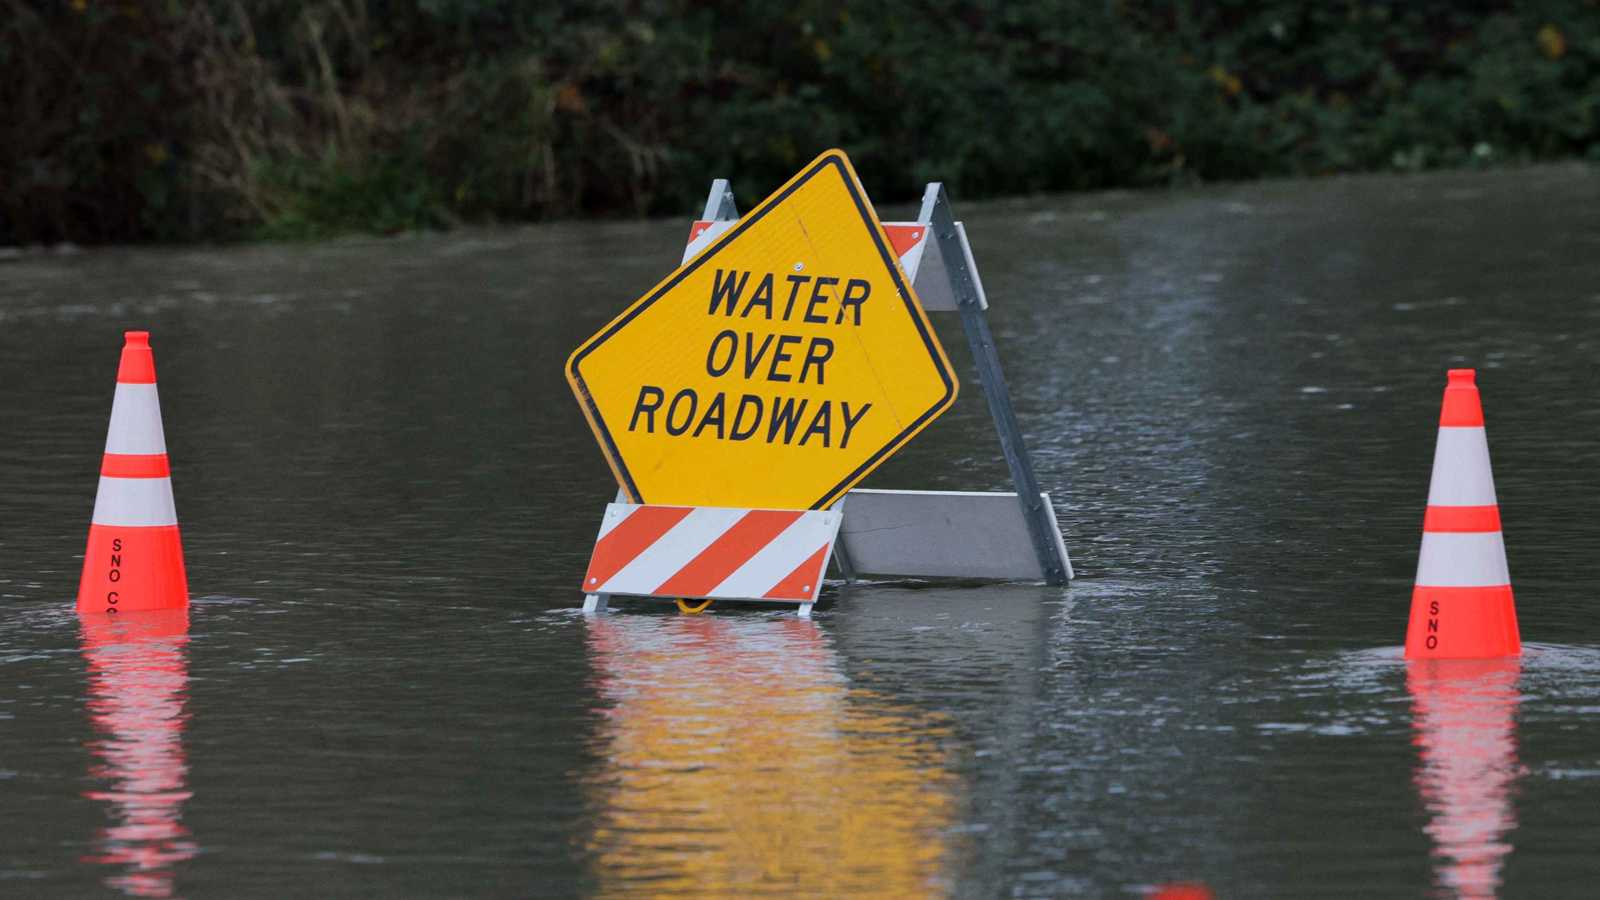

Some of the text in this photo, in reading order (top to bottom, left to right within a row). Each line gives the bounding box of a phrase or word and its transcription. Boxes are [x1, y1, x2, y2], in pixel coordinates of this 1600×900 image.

[707, 269, 871, 326] WATER
[705, 329, 834, 385] OVER
[628, 385, 872, 449] ROADWAY
[109, 538, 122, 582] SNO
[1425, 600, 1440, 650] SNO
